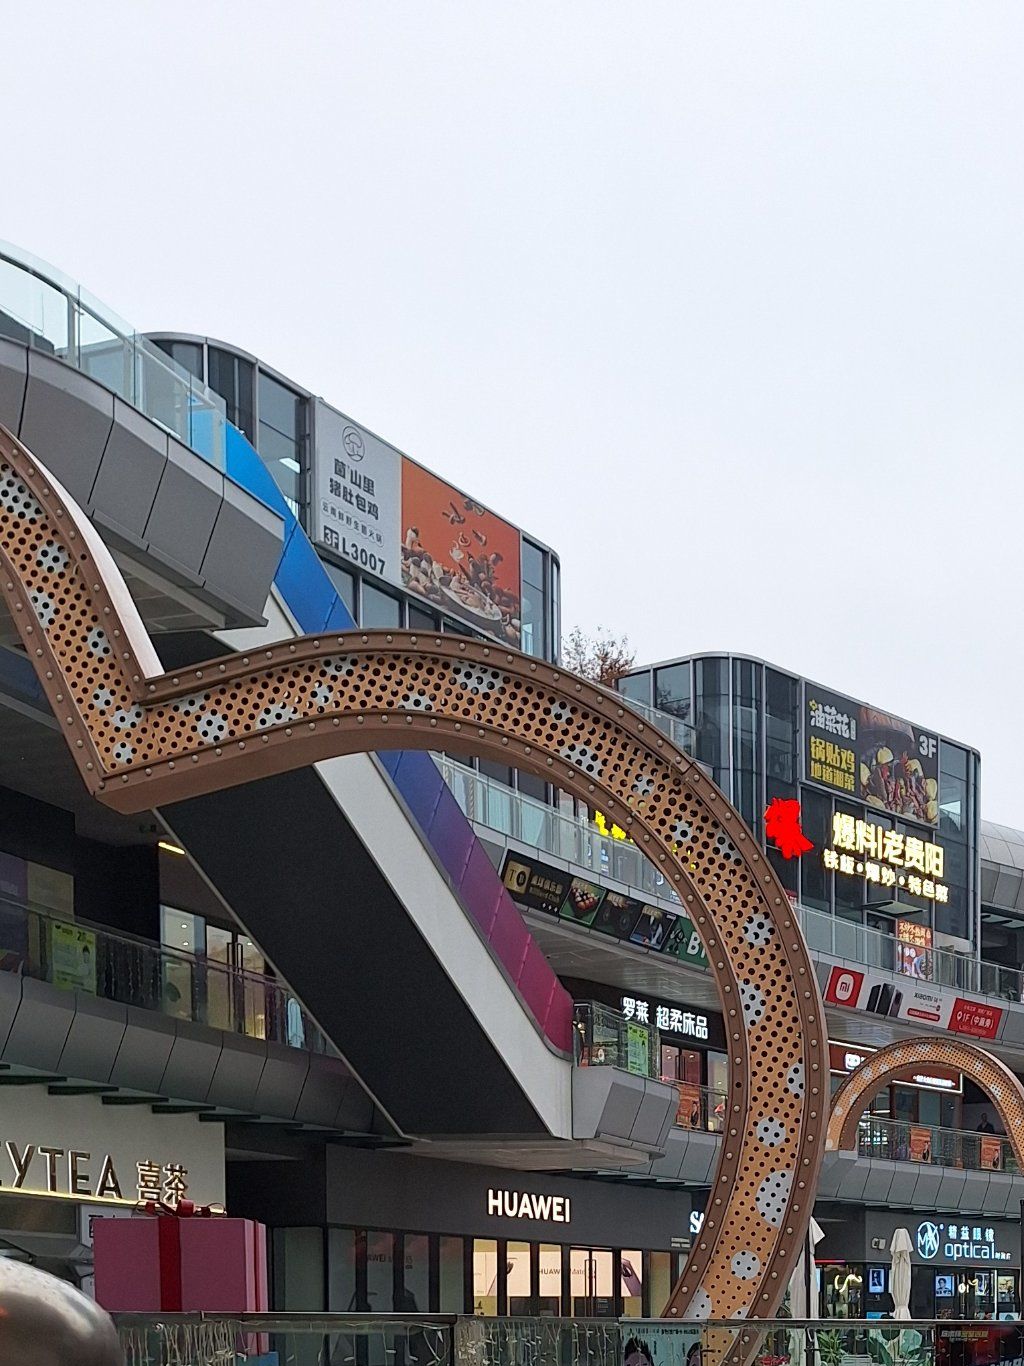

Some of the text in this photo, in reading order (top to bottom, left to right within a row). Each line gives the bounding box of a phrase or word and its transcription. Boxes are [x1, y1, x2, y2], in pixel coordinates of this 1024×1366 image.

[342, 537, 386, 576] L3007
[919, 735, 937, 759] 3F
[622, 996, 709, 1040] 罗莱 超柔床品
[0, 1140, 189, 1204] YTEA 喜茶
[486, 1188, 571, 1223] HUAWEI
[948, 1224, 995, 1242] 精益眼镜
[944, 1242, 995, 1261] optical
